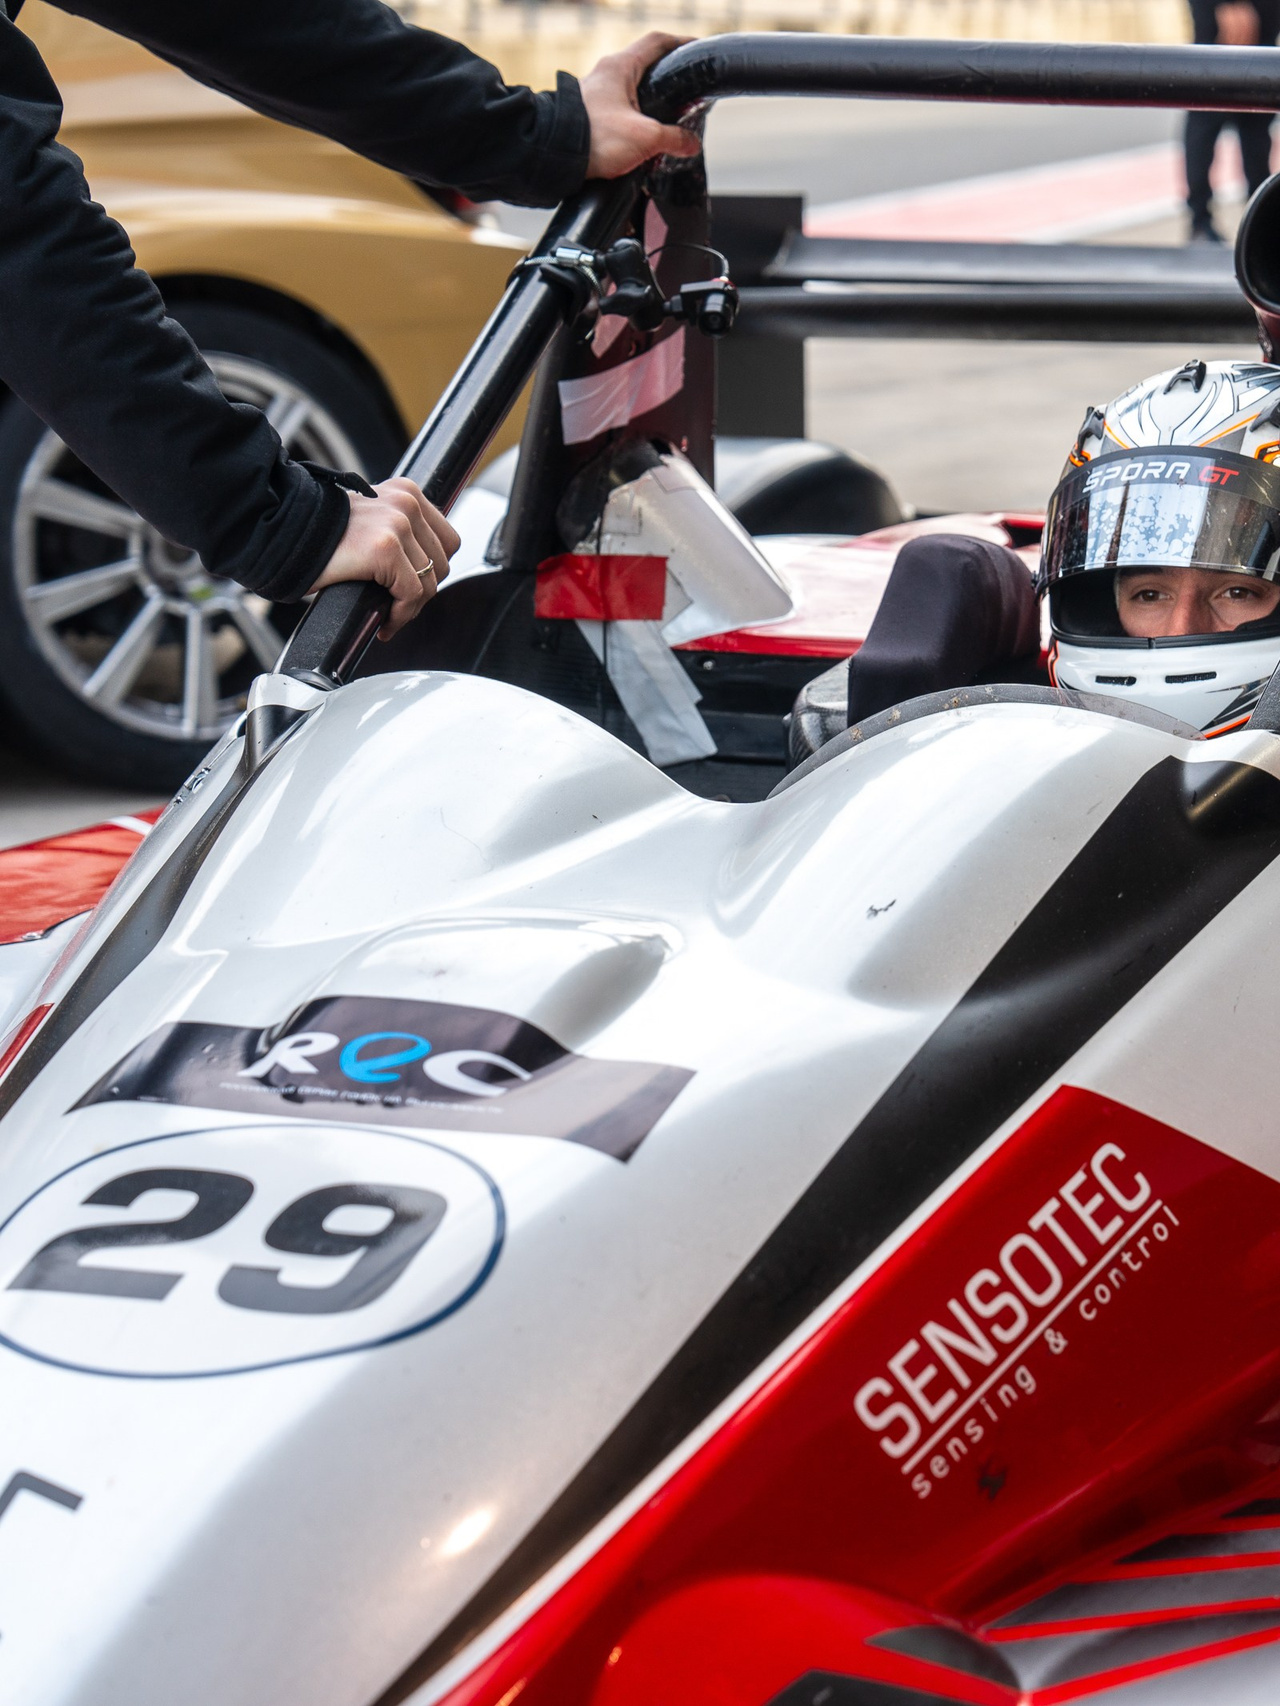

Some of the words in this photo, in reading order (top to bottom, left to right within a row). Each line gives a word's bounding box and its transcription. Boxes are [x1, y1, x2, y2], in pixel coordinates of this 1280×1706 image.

[1082, 461, 1191, 494] SPORA
[1198, 465, 1239, 486] GT
[5, 1166, 448, 1315] 29
[853, 1142, 1151, 1459] SENSOTEC
[911, 1364, 1038, 1500] sensing
[1043, 1327, 1070, 1355] &
[1078, 1204, 1180, 1321] control
